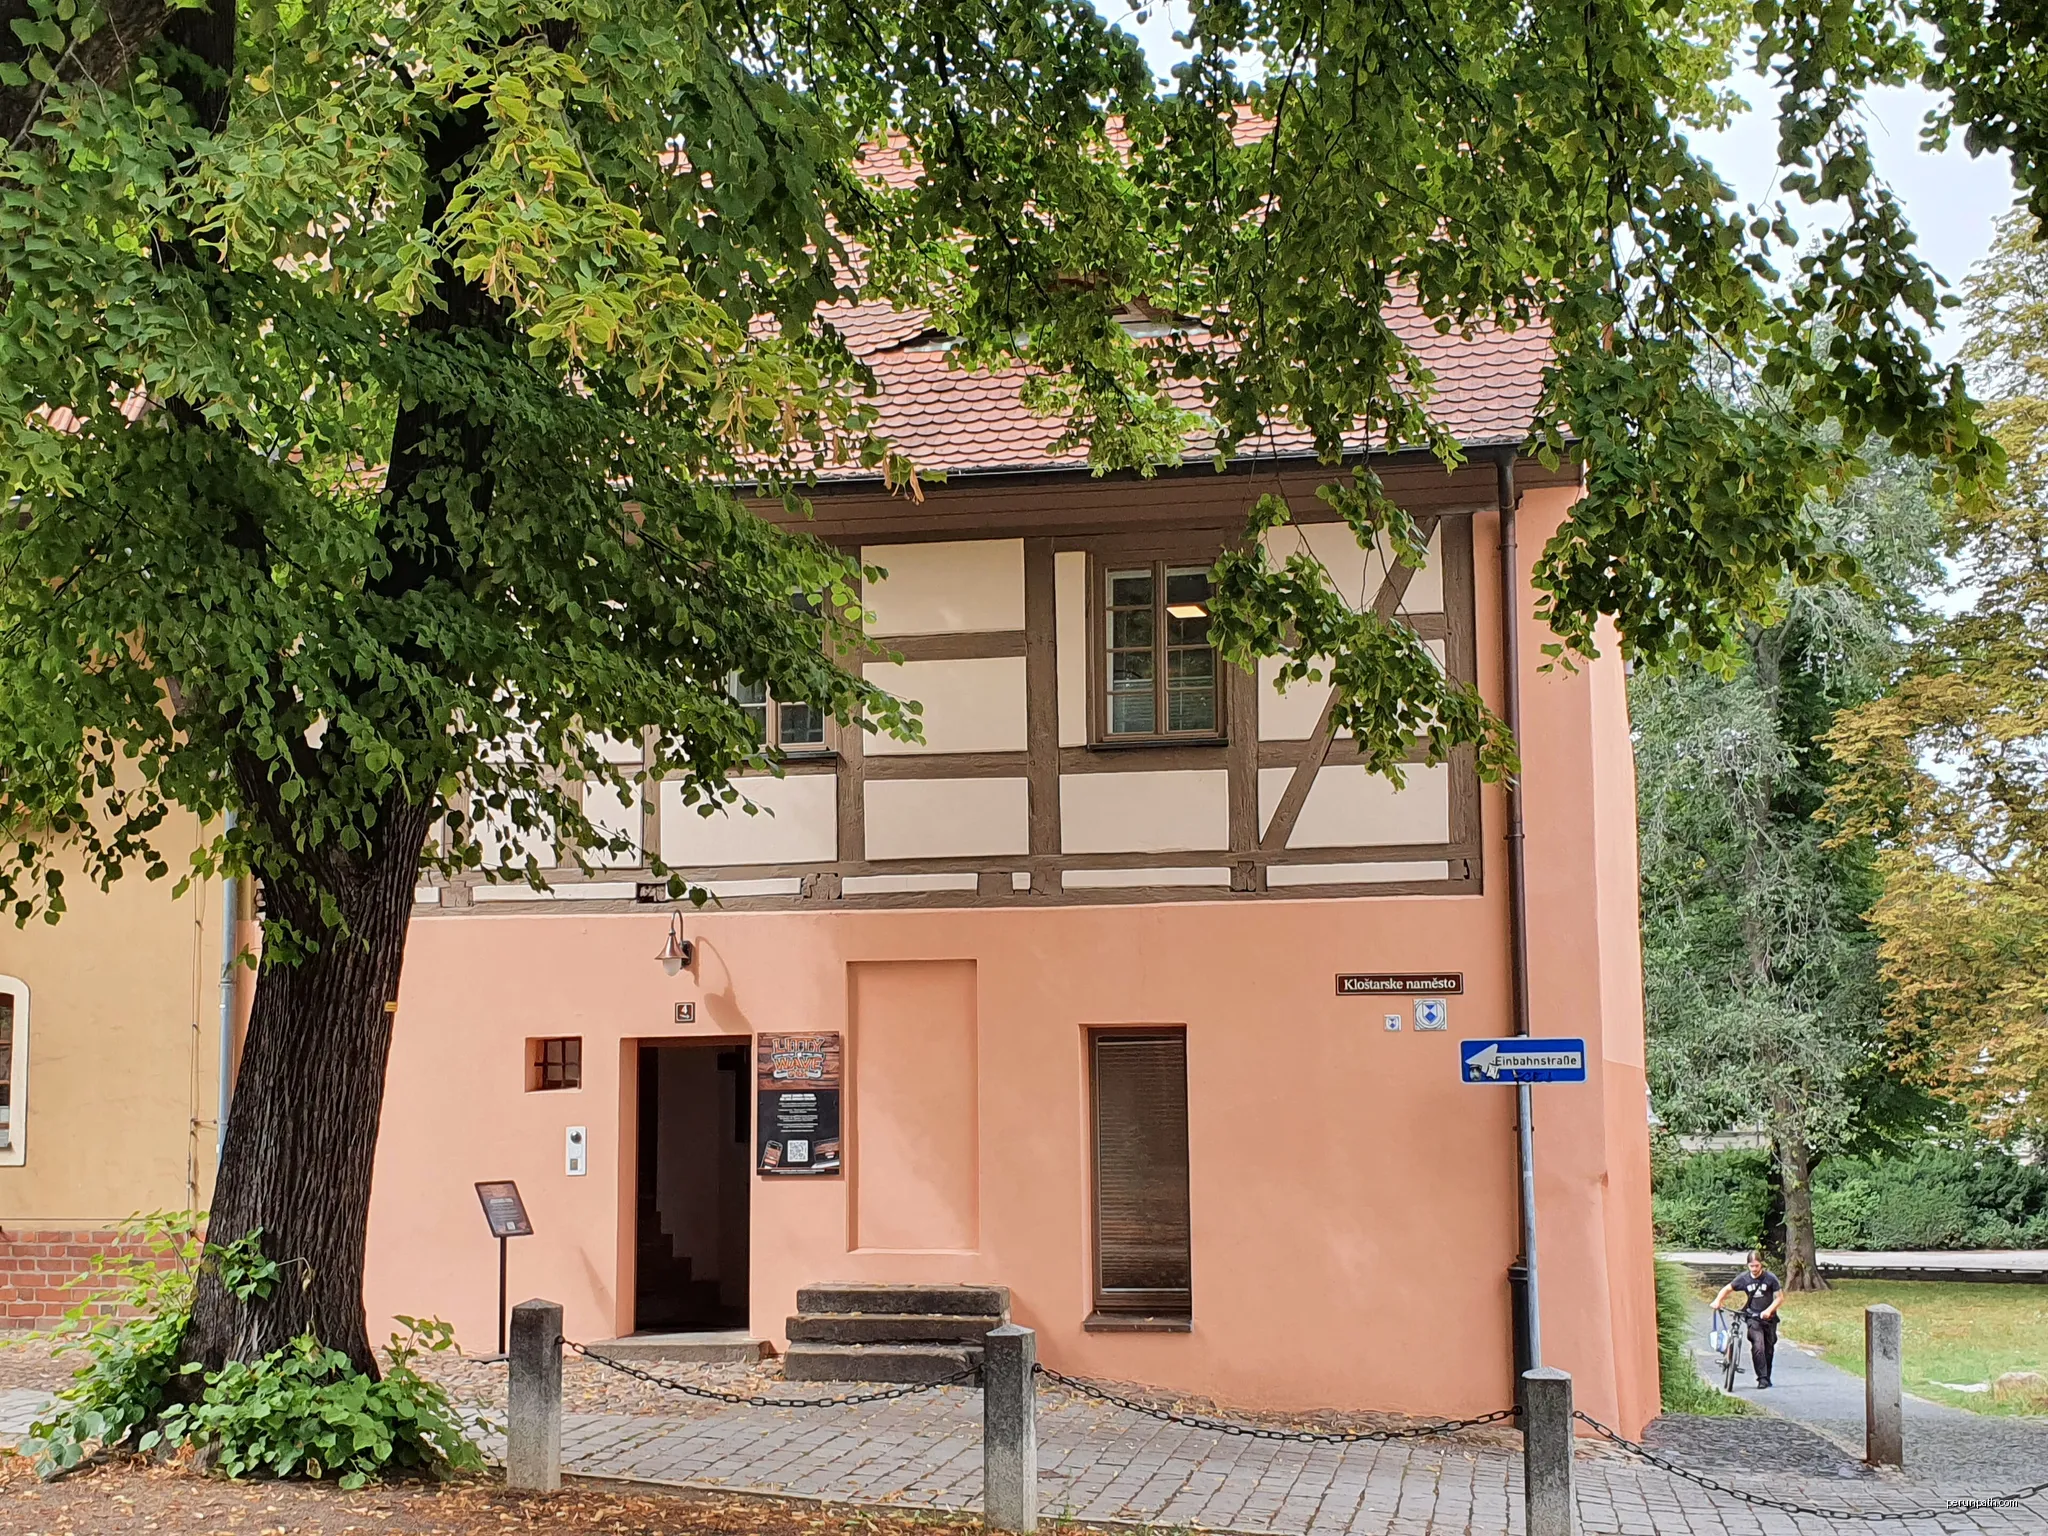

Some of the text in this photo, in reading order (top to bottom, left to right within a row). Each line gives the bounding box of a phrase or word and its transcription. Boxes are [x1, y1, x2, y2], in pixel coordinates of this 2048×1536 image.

[1344, 977, 1456, 991] Kloštarske naměsto
[774, 1056, 824, 1070] WAVE
[1495, 1055, 1577, 1067] Einbahnstraße
